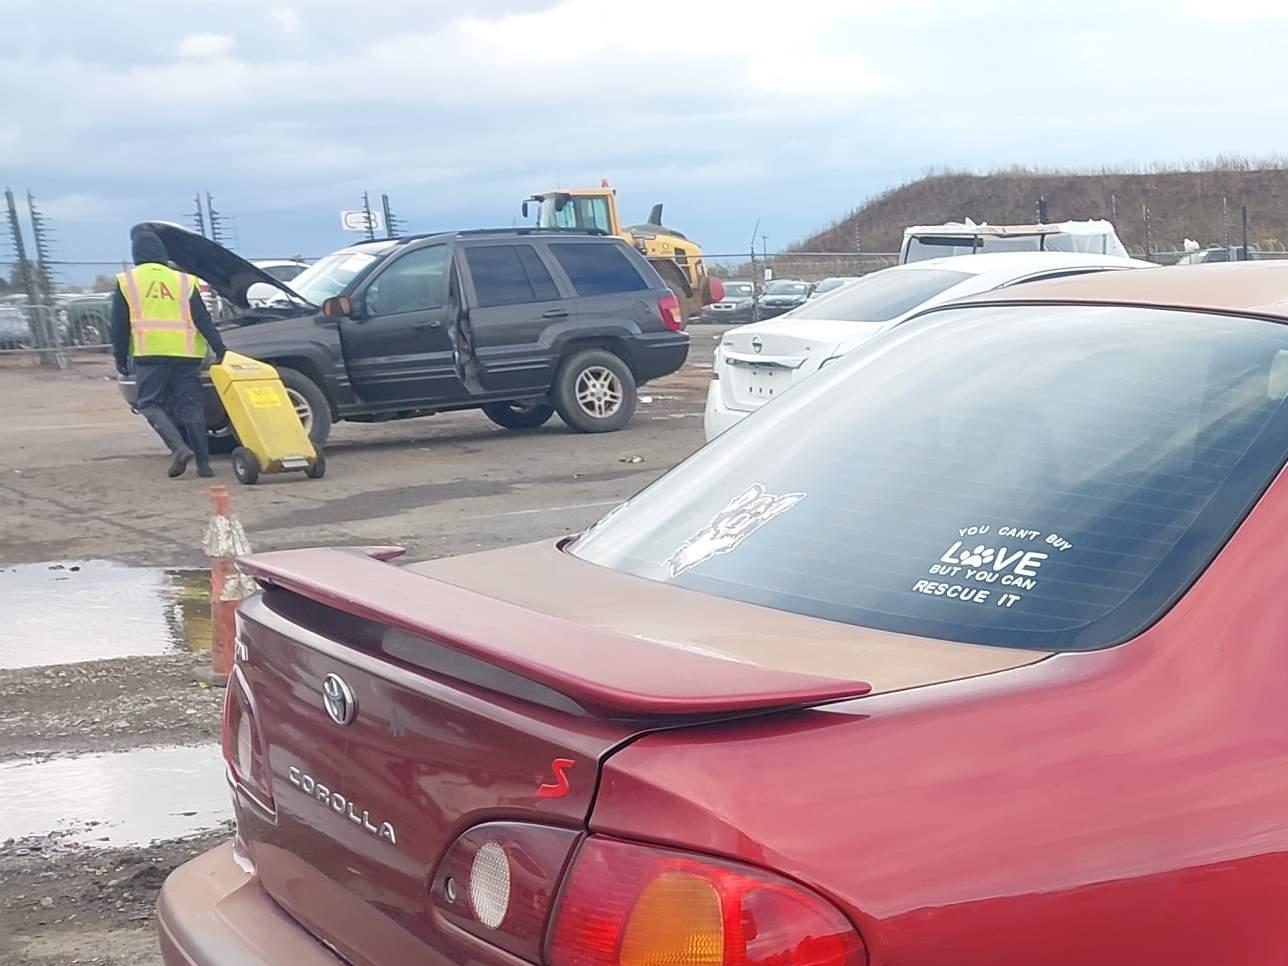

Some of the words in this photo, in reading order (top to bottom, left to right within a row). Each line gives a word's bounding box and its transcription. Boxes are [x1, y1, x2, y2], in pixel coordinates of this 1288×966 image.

[959, 525, 990, 537] YOU
[998, 526, 1040, 541] CAN'T
[1045, 533, 1072, 551] BUY
[929, 564, 961, 577] BUT
[965, 569, 999, 583] YOU
[1001, 574, 1036, 591] CAN
[912, 580, 990, 603] RESCUE
[998, 593, 1020, 608] IT
[535, 757, 576, 799] S
[289, 766, 396, 844] COROLLA
